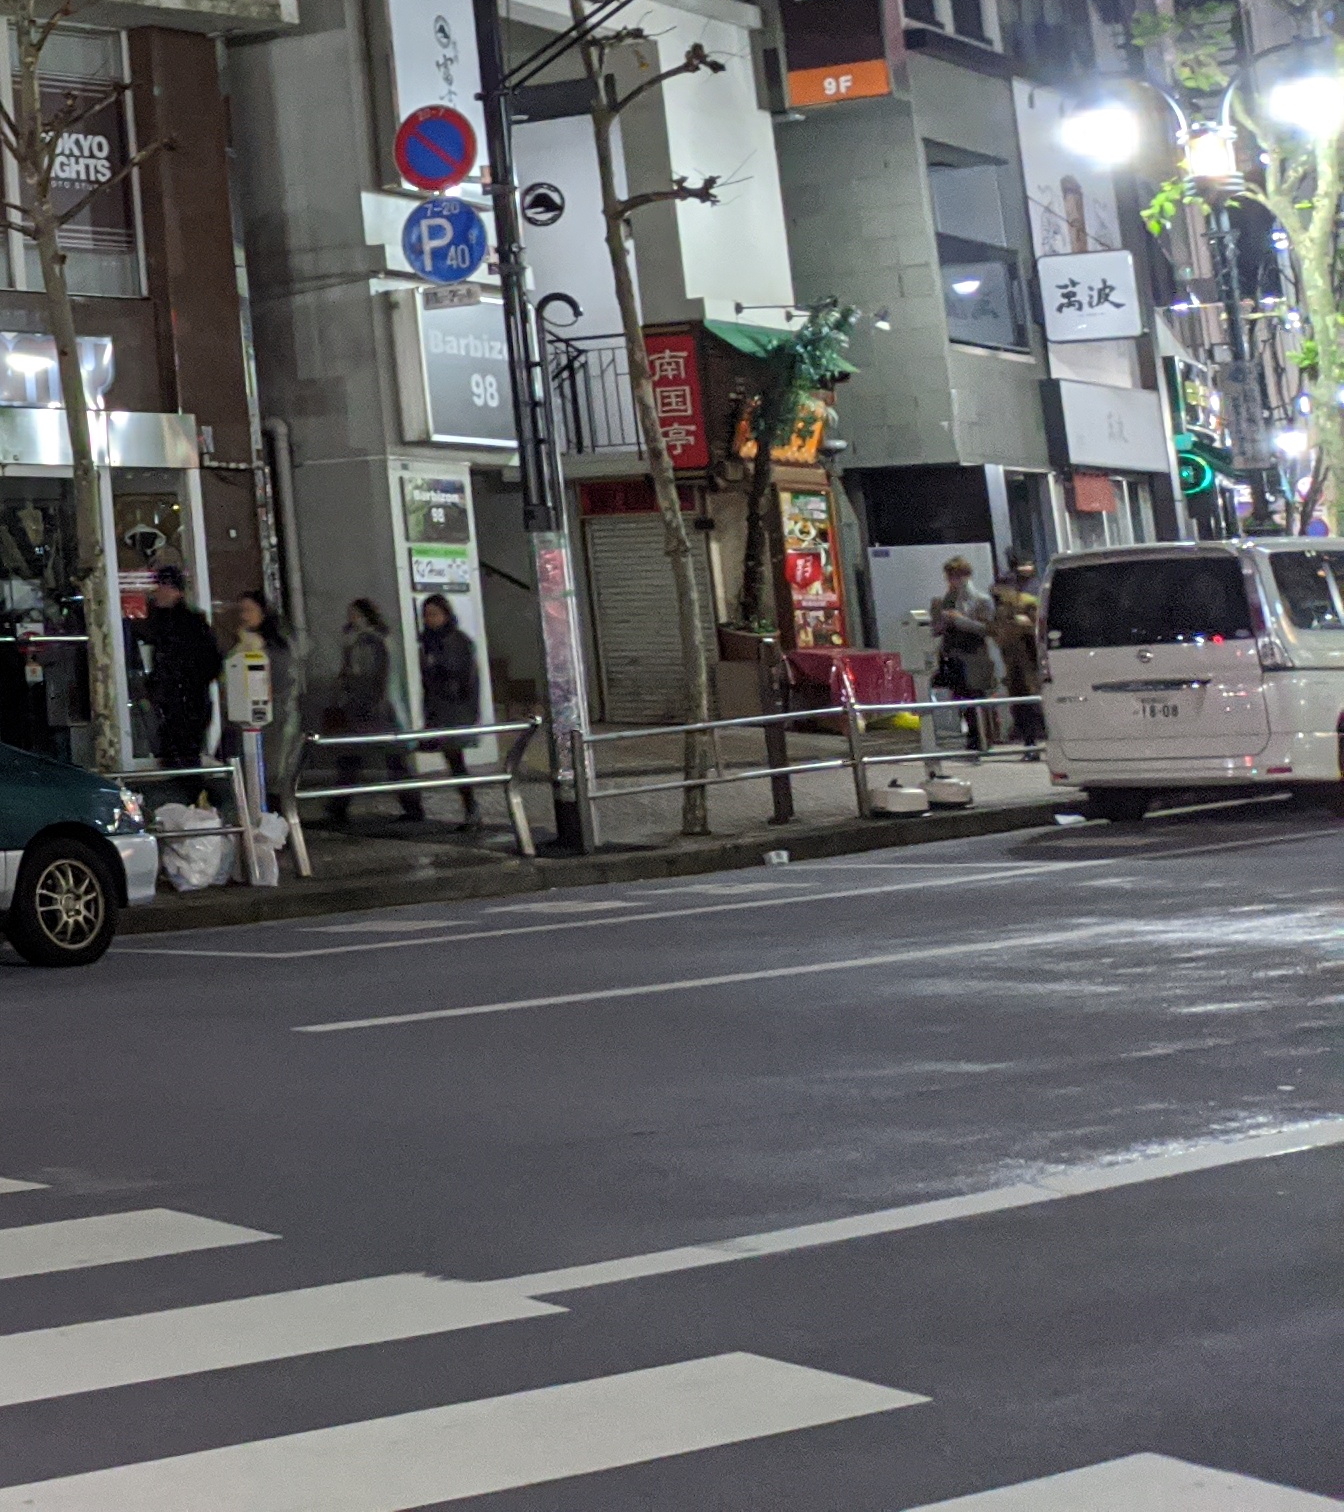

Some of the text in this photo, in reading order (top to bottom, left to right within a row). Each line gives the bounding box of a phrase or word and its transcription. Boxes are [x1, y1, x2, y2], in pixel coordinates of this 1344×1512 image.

[823, 75, 853, 96] 9F
[425, 201, 460, 217] 7-20
[420, 217, 470, 272] P 40
[1055, 277, 1127, 315] 萬波
[471, 373, 500, 407] 98
[649, 349, 697, 455] 南国亭
[430, 507, 445, 523] 98
